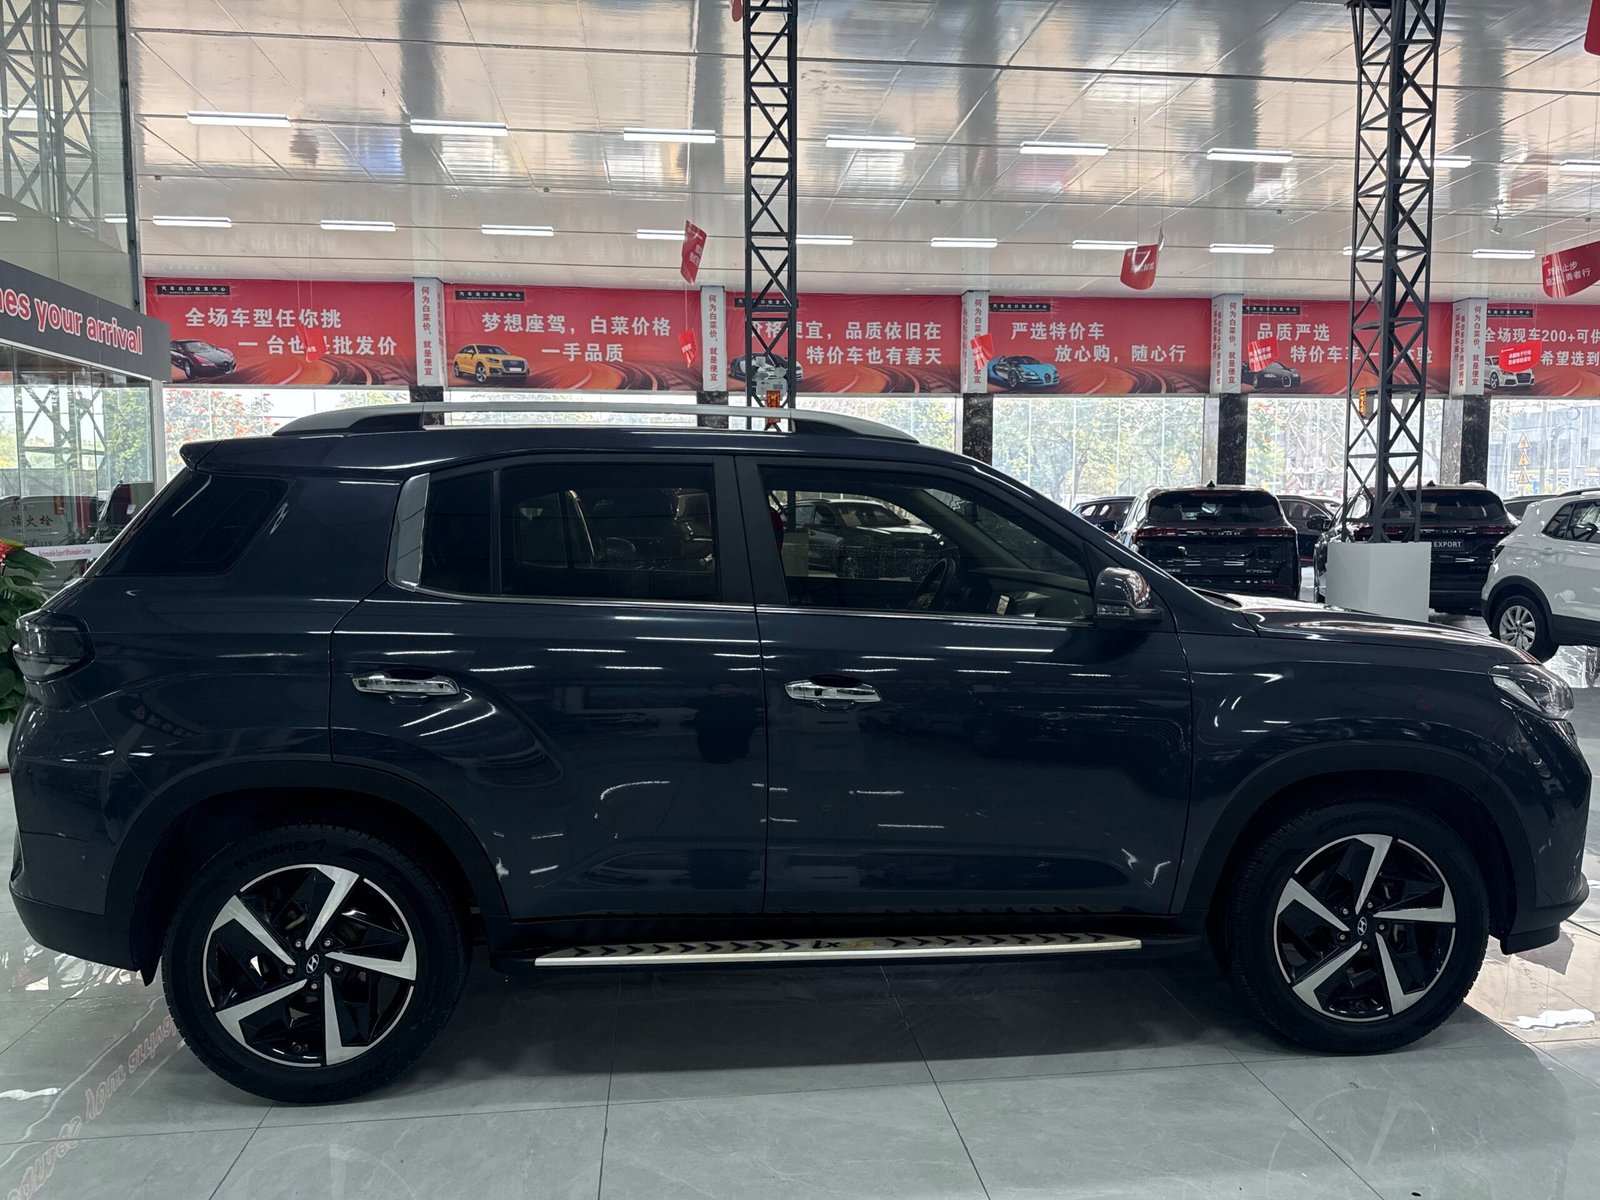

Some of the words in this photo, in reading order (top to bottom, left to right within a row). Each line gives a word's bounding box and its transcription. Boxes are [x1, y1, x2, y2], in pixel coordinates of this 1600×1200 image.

[0, 288, 31, 320] es
[34, 298, 83, 332] your
[86, 316, 143, 355] arrival
[185, 307, 342, 329] 全场车型任你挑
[481, 312, 671, 337] 梦想座驾，白菜价格
[1011, 321, 1105, 341] 严选特价车
[1257, 323, 1330, 342] 品质严选
[238, 335, 397, 356] 一台也批发价
[541, 342, 624, 363] 一手品质
[1054, 344, 1186, 364] 放心购，随心行
[806, 346, 942, 366] 特价车也有春天
[1541, 350, 1600, 367] 希望选到
[1433, 541, 1462, 549] EXPORT
